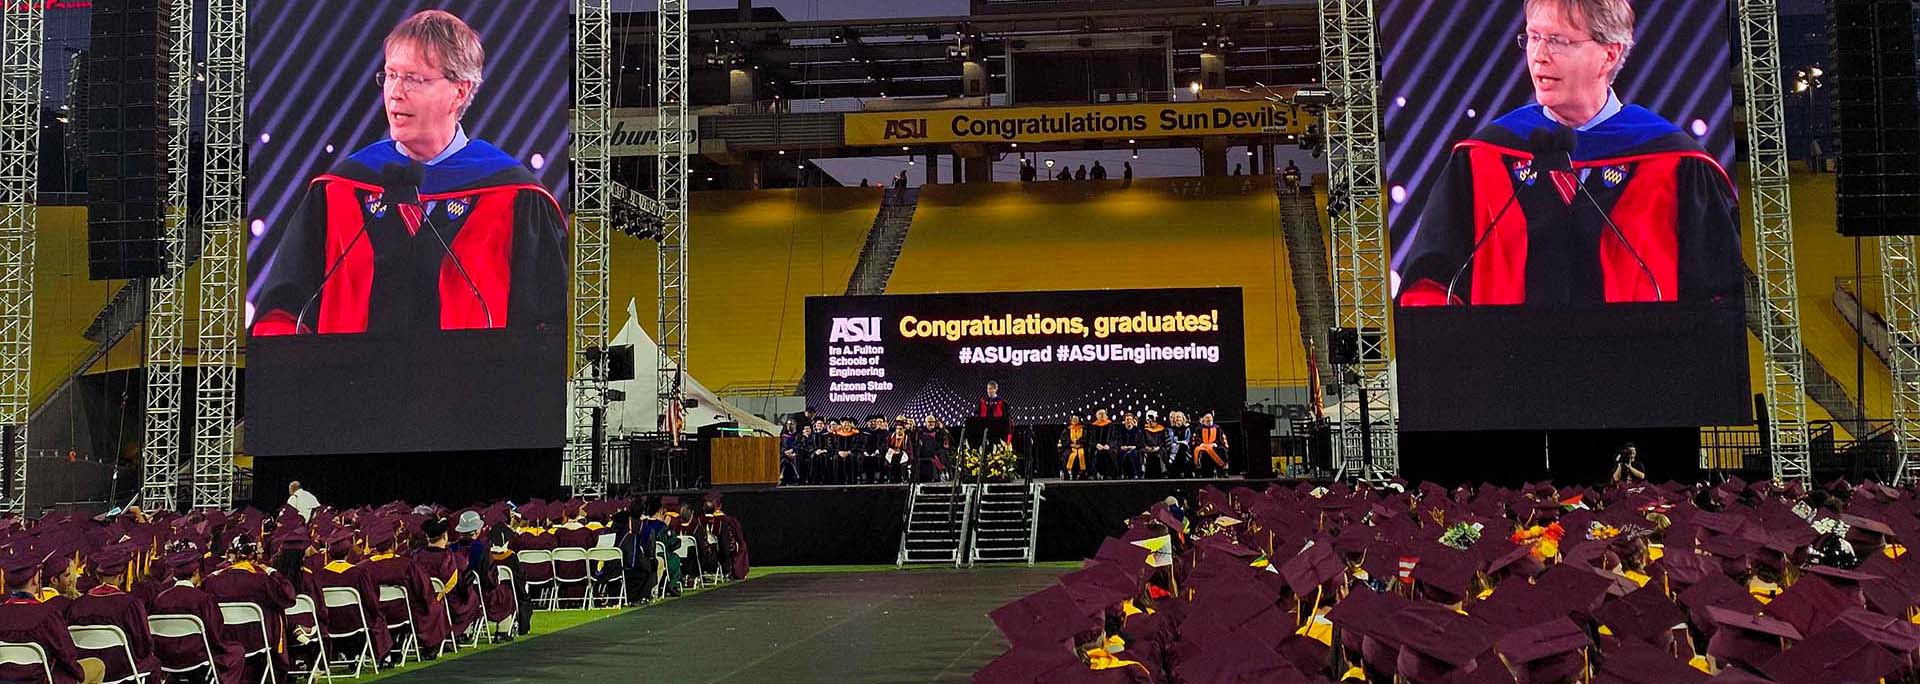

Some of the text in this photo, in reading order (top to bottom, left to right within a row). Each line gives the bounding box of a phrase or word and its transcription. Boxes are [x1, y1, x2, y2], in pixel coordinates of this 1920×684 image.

[884, 118, 928, 140] ASU
[952, 104, 1298, 139] Congratulations Sun Devils!
[829, 317, 883, 342] ASU
[899, 310, 1219, 341] Congratulations, graduates!
[829, 346, 842, 355] Ira
[854, 345, 884, 355] Fulton
[958, 342, 1220, 366] #ASUgrad #ASUEngineering
[829, 355, 880, 366] Schools of
[829, 367, 885, 378] Engineering
[829, 380, 893, 391] Arizona State
[829, 392, 877, 403] University
